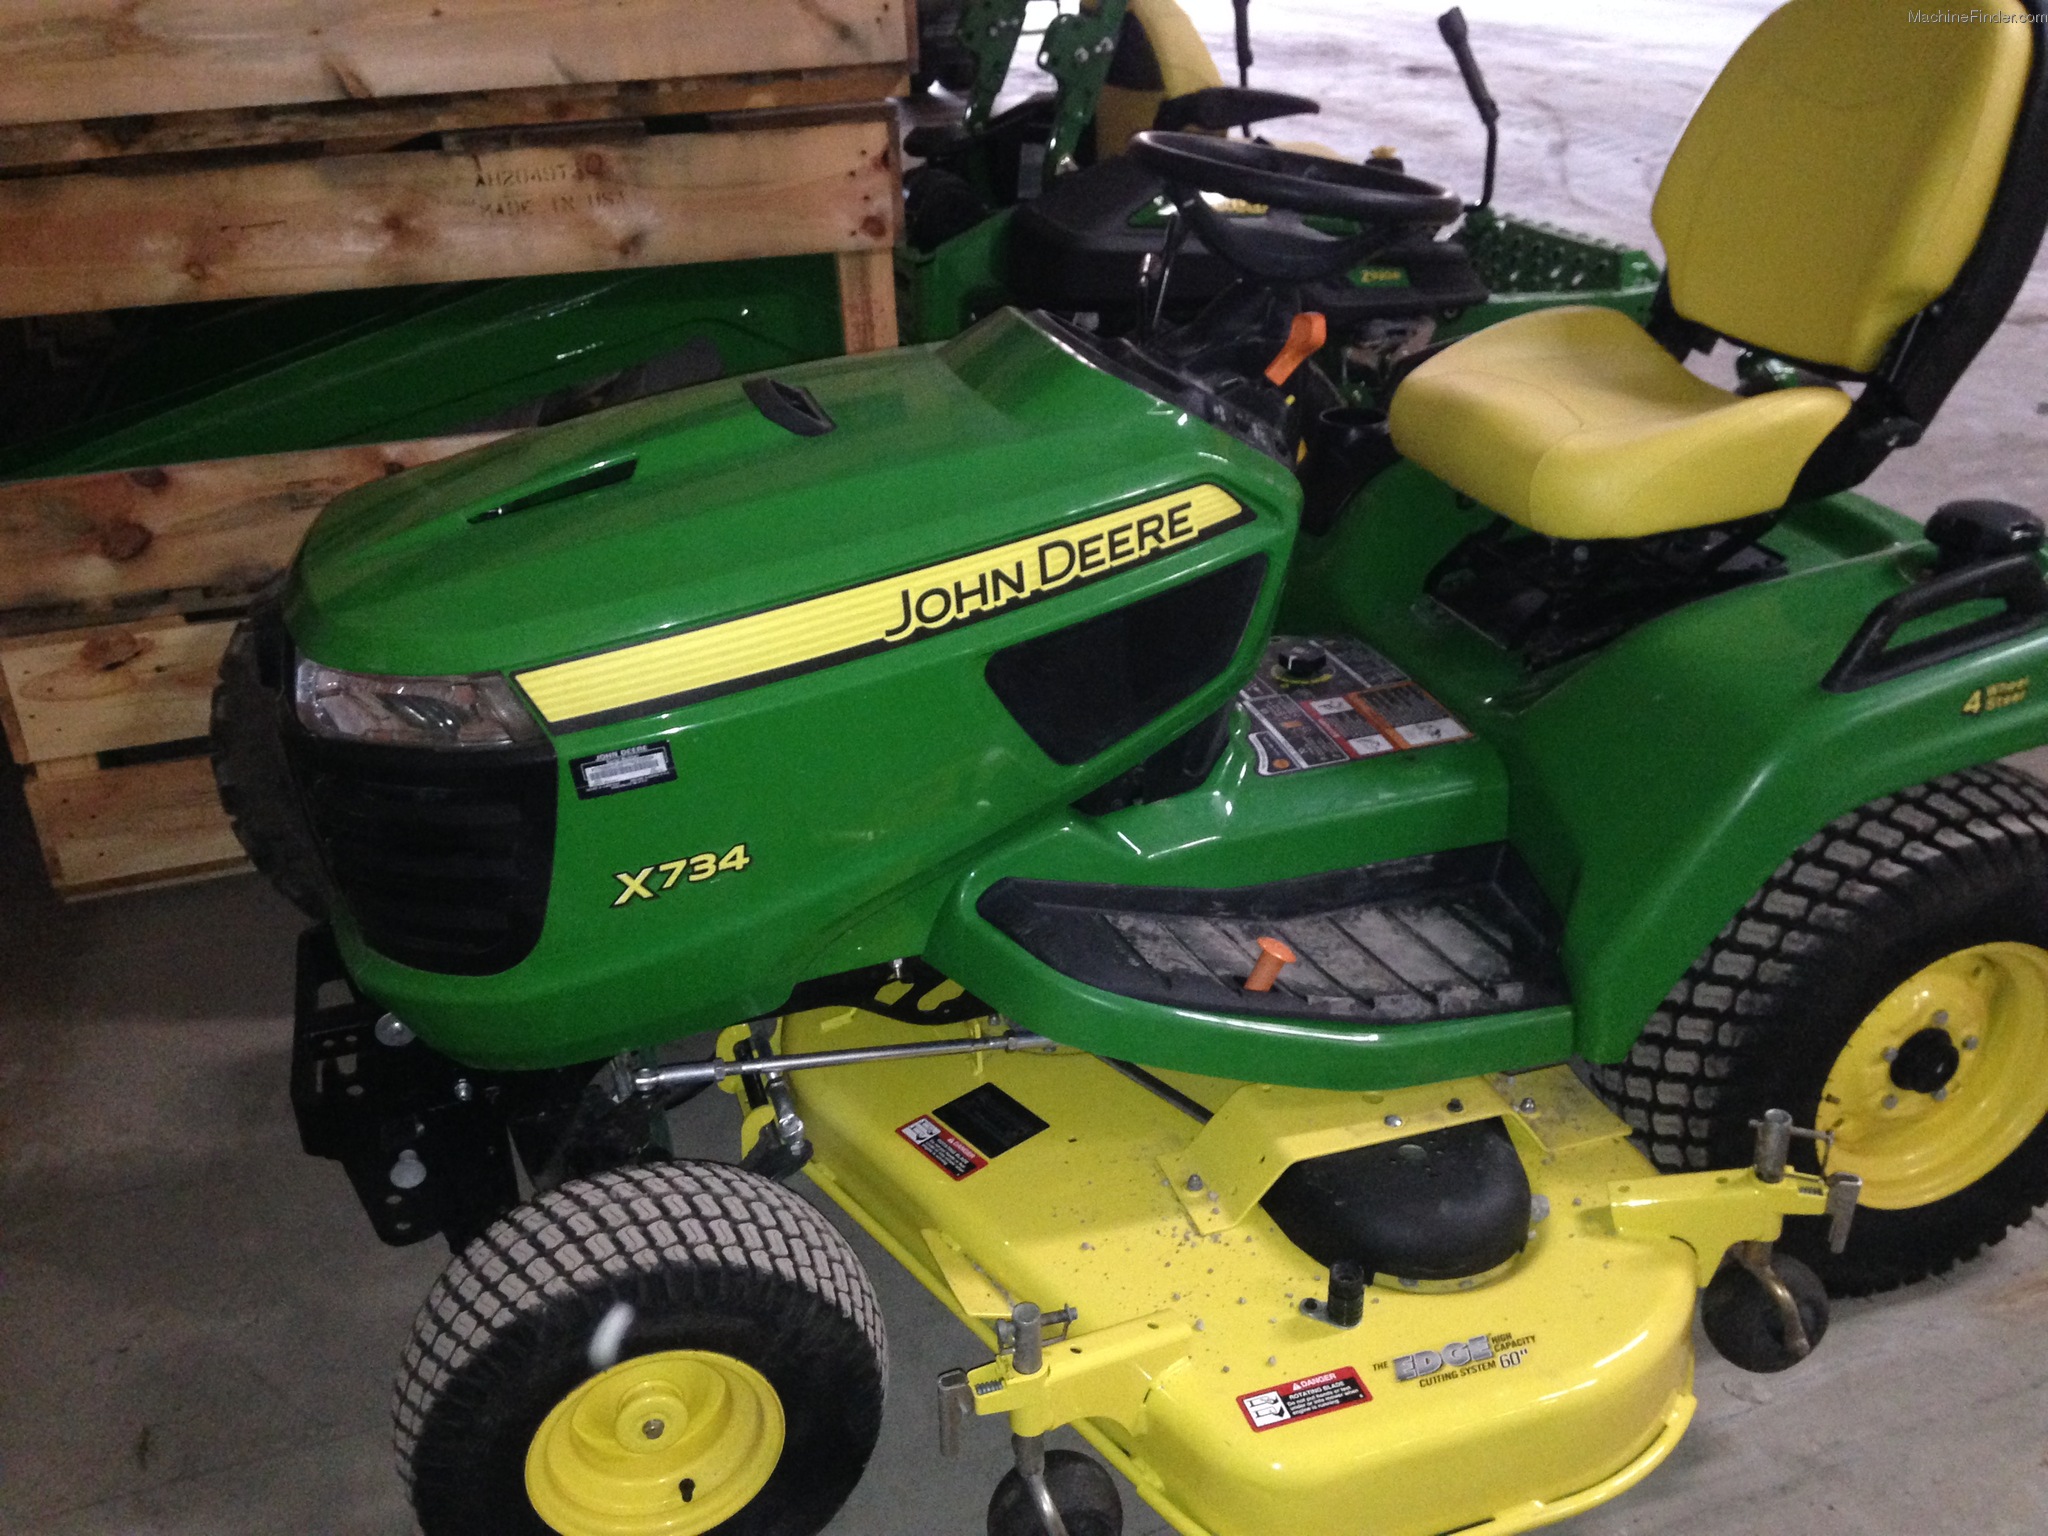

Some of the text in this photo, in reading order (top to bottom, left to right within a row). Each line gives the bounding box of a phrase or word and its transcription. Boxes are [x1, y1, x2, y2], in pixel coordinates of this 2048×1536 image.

[884, 501, 1194, 638] JOHN DEERE
[1961, 689, 1981, 714] 4
[596, 745, 647, 761] JOHN DEERE
[611, 843, 751, 907] X734
[1492, 1332, 1512, 1344] HIGH
[1494, 1335, 1536, 1352] CAPACITY
[1372, 1334, 1494, 1381] THE EDGE
[1299, 1372, 1337, 1387] DANGER
[1419, 1372, 1458, 1387] CUTTING
[1460, 1360, 1496, 1377] SYSTEM
[1288, 1381, 1345, 1400] ROTATING BLADE
